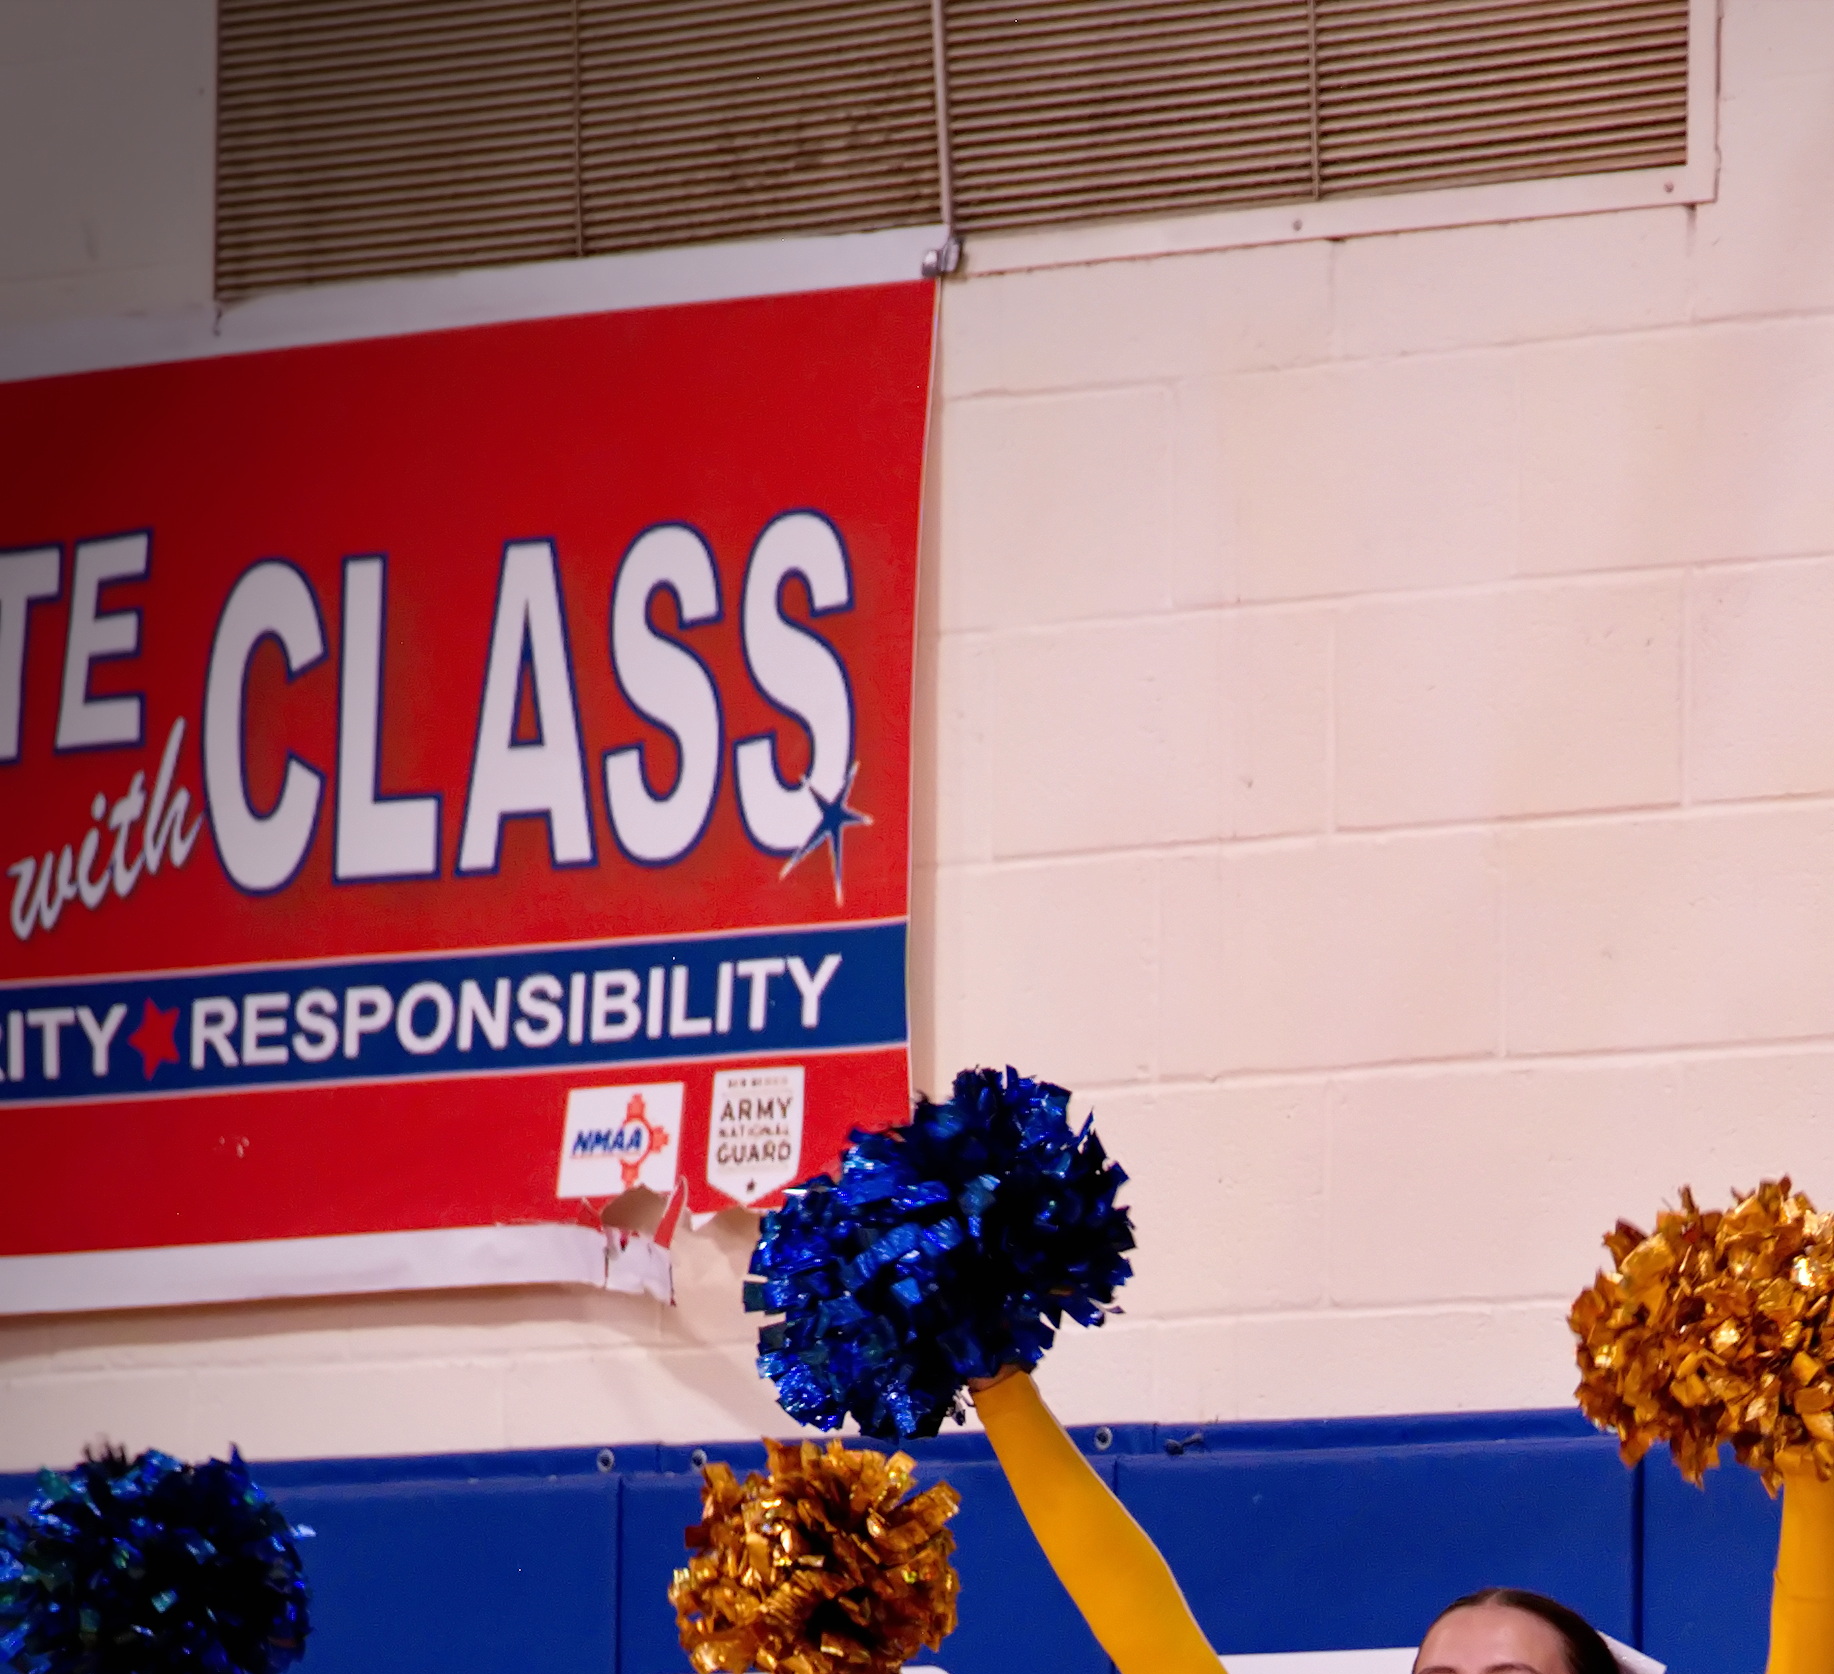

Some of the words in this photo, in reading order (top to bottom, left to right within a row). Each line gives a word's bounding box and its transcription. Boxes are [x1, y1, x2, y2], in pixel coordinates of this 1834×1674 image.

[8, 714, 203, 941] with
[202, 508, 857, 897] CLASS
[0, 1002, 129, 1083] ITY
[190, 953, 843, 1071] RESPONSIBILITY
[720, 1096, 793, 1121] ARMY
[572, 1126, 644, 1156] NMAA
[716, 1140, 792, 1165] GUARD
